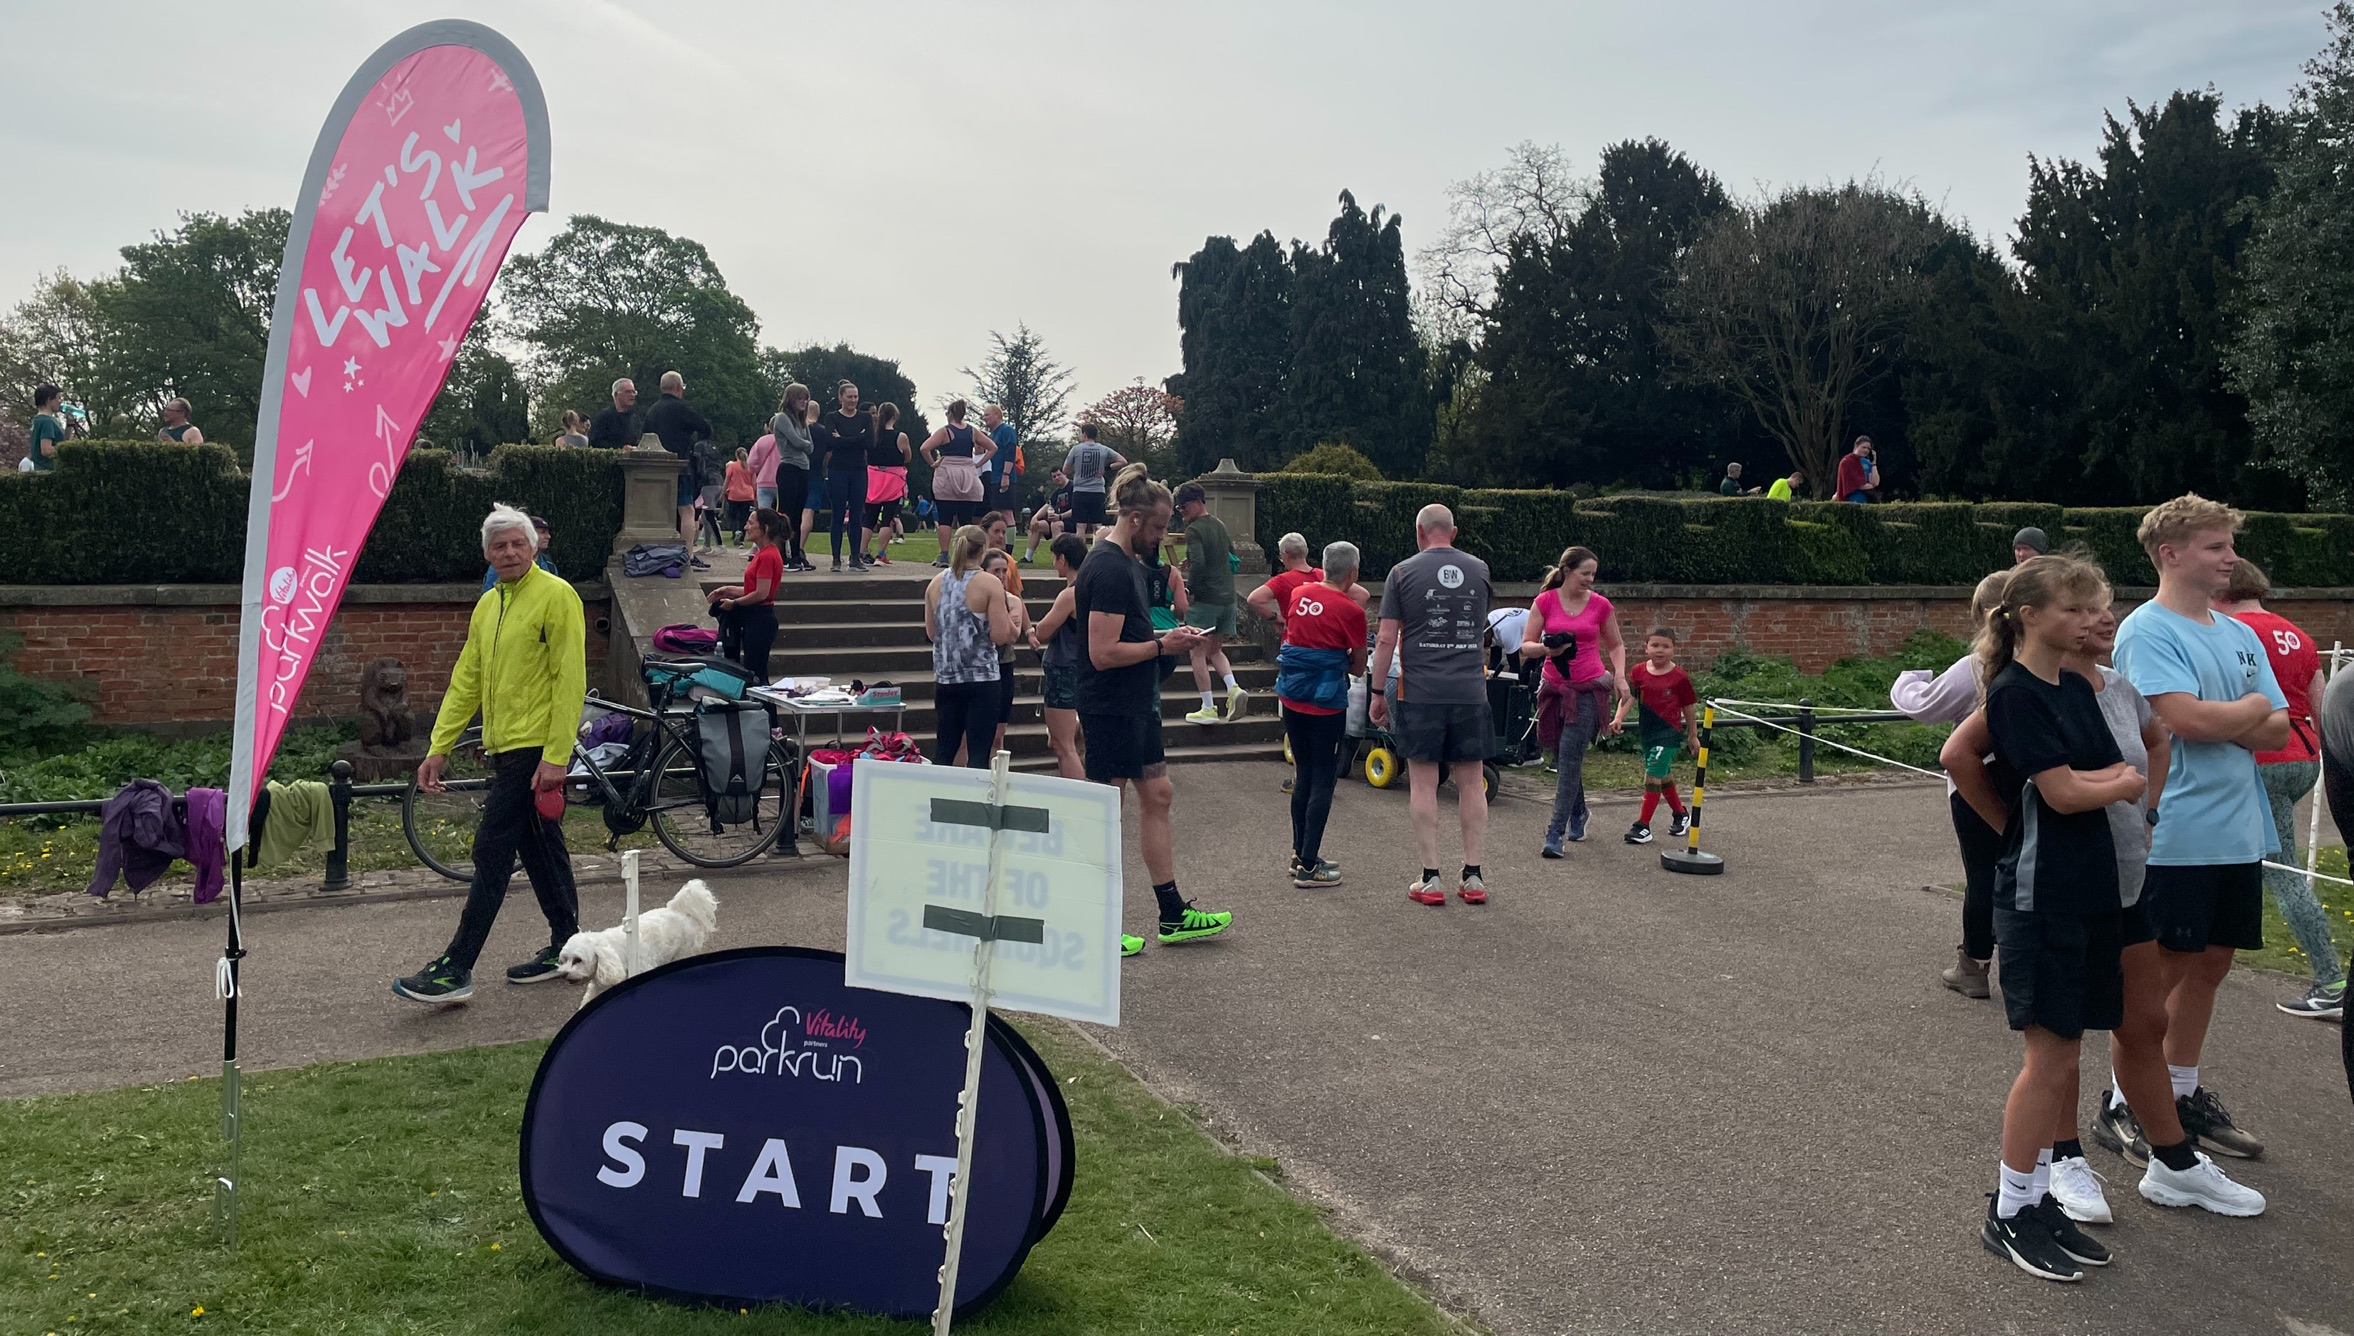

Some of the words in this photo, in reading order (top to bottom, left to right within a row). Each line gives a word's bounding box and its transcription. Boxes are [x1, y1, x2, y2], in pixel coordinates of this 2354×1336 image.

[304, 131, 441, 347] LET'S
[354, 146, 504, 348] WALK
[266, 545, 347, 713] parkwalk
[1296, 596, 1324, 617] 50
[2235, 650, 2257, 667] NK
[2272, 629, 2301, 656] 50
[1655, 745, 1665, 760] 7
[711, 1022, 861, 1084] parkrun
[806, 1008, 867, 1049] Vitality
[596, 1120, 958, 1225] START
